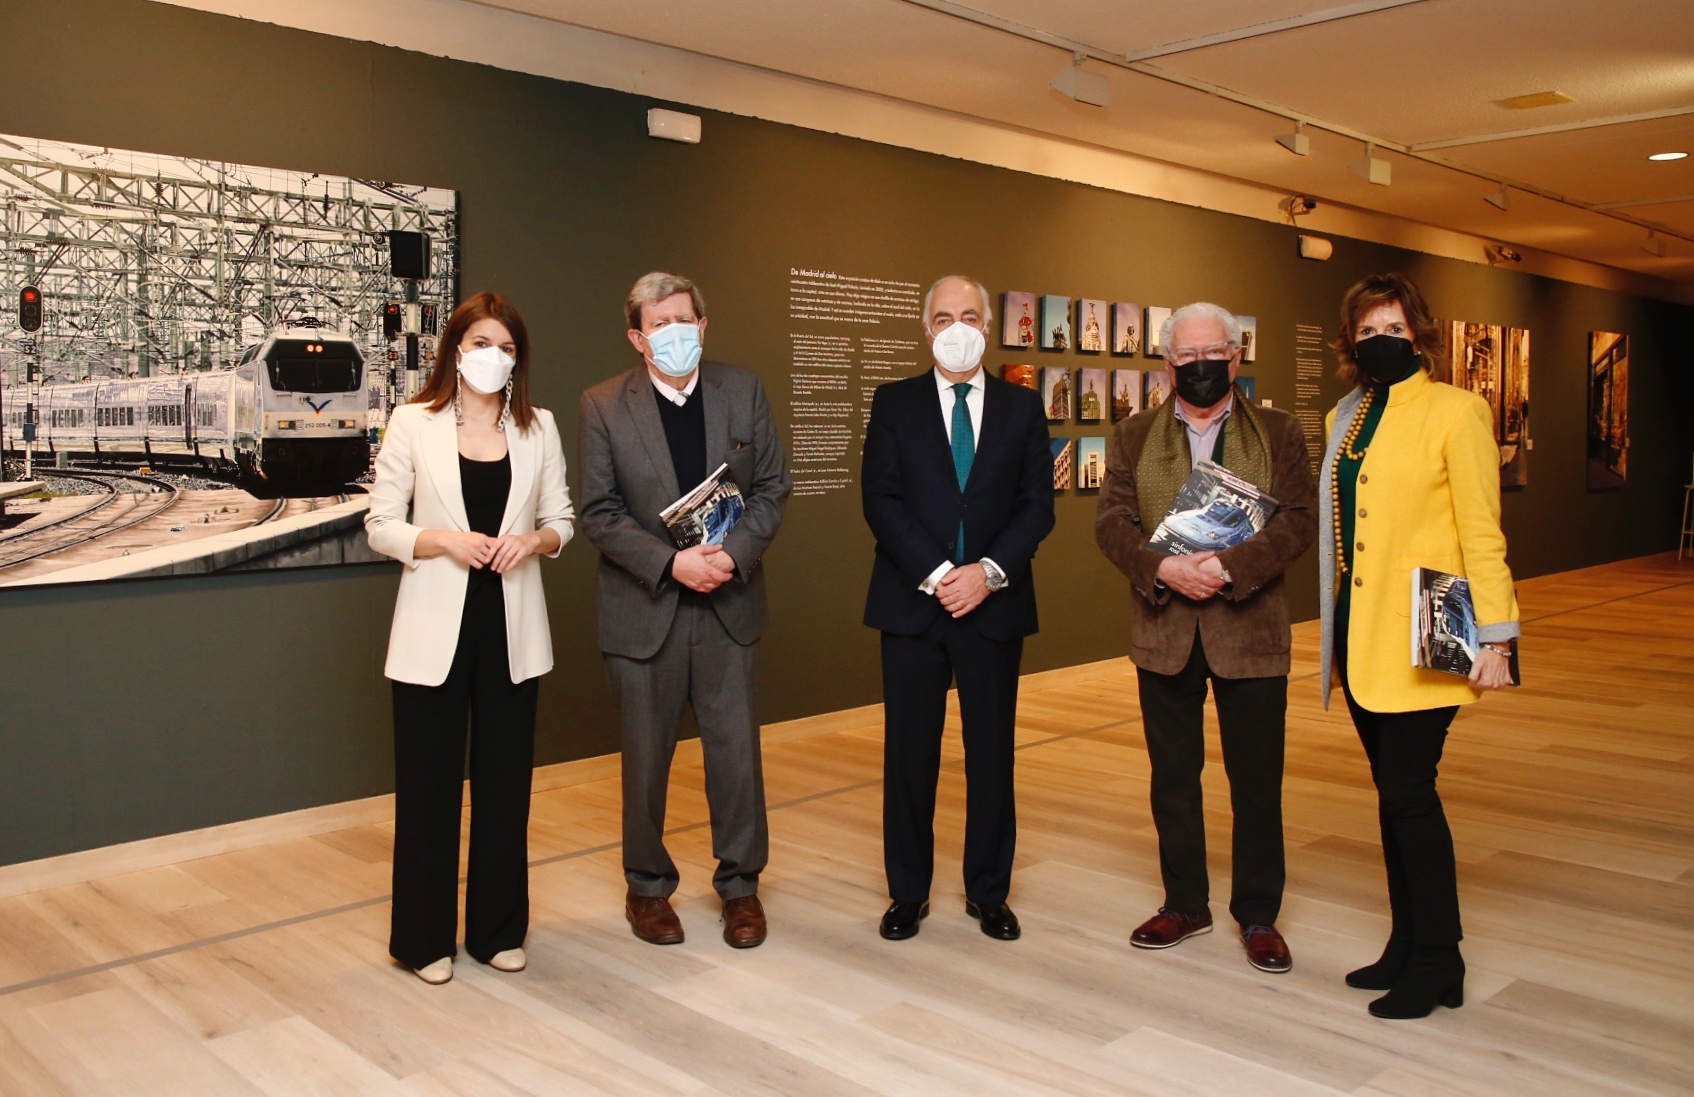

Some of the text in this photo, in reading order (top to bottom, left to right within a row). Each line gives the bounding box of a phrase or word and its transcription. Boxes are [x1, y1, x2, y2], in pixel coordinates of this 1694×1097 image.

[790, 267, 838, 279] De Madrid al cielo
[25, 345, 36, 354] S2
